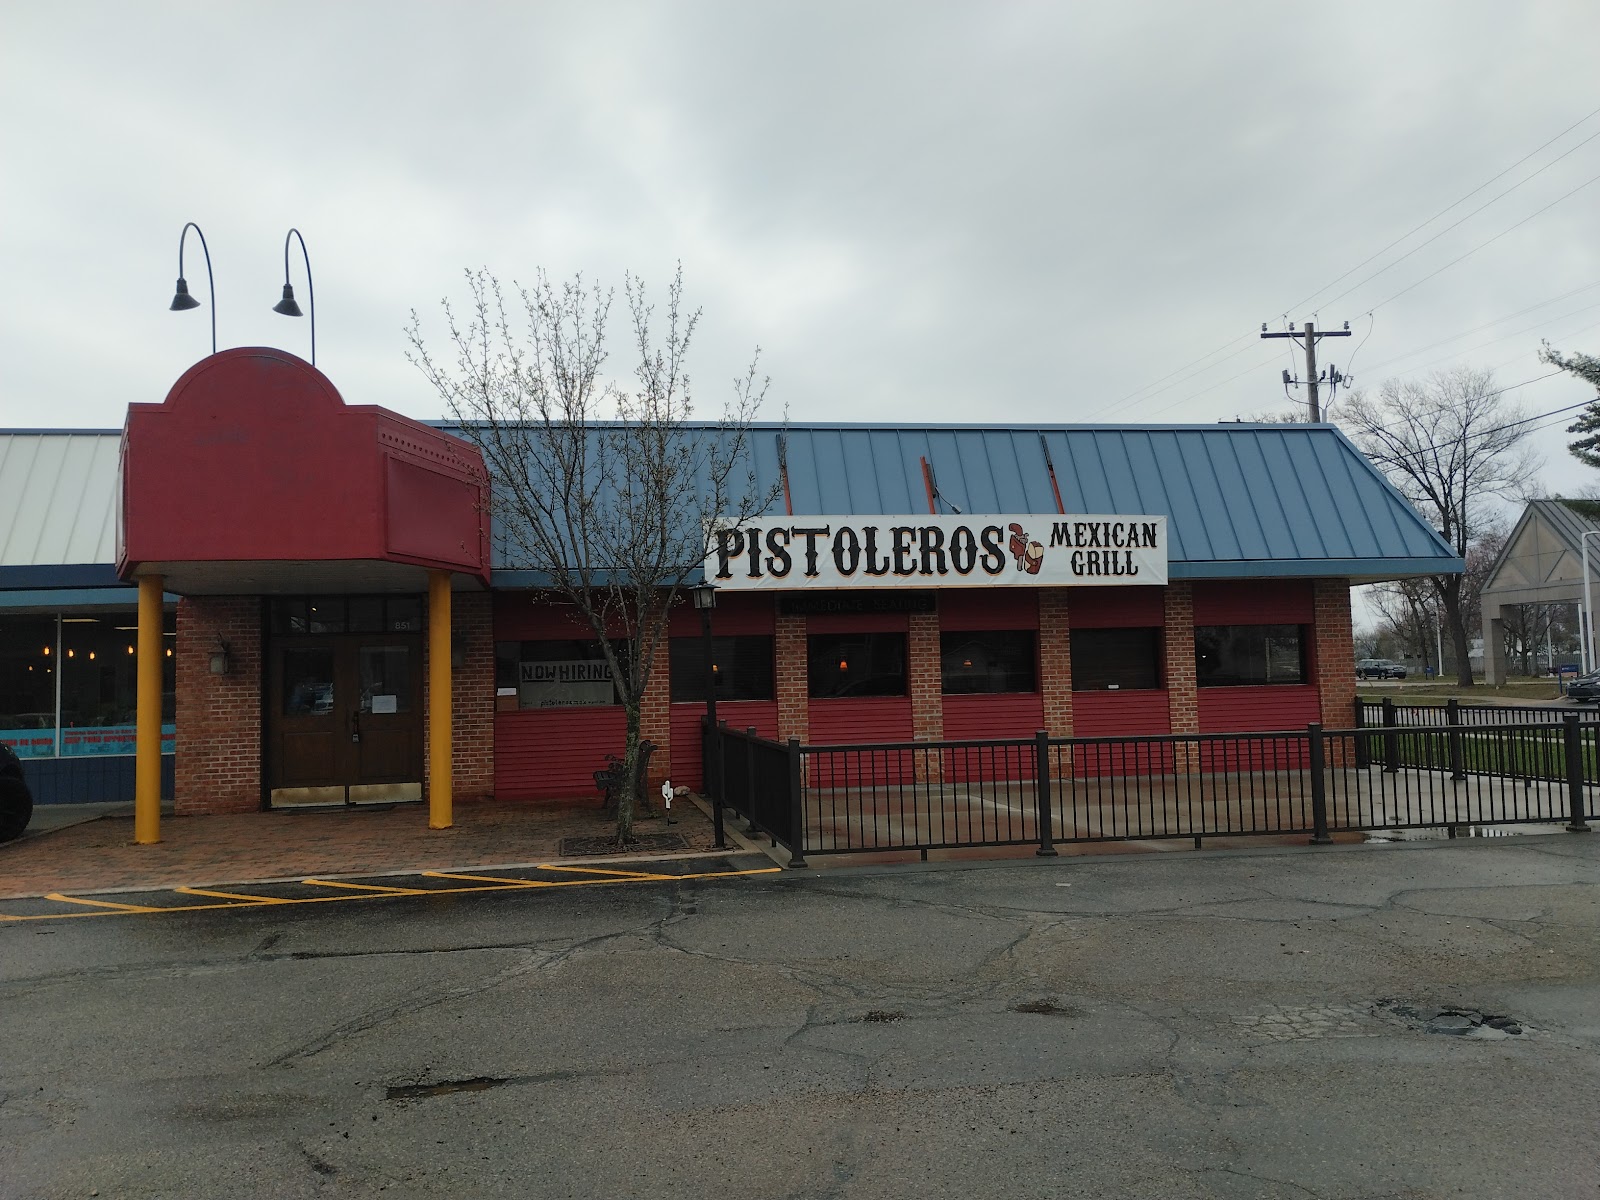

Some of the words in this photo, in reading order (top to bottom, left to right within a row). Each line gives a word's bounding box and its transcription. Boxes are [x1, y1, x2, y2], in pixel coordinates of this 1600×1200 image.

[1049, 522, 1158, 548] MEXICAN
[715, 525, 1004, 579] PISTOLEROS
[1070, 550, 1139, 576] GRILL
[394, 621, 411, 630] 851
[521, 665, 556, 680] NOW
[559, 664, 613, 680] HIRING
